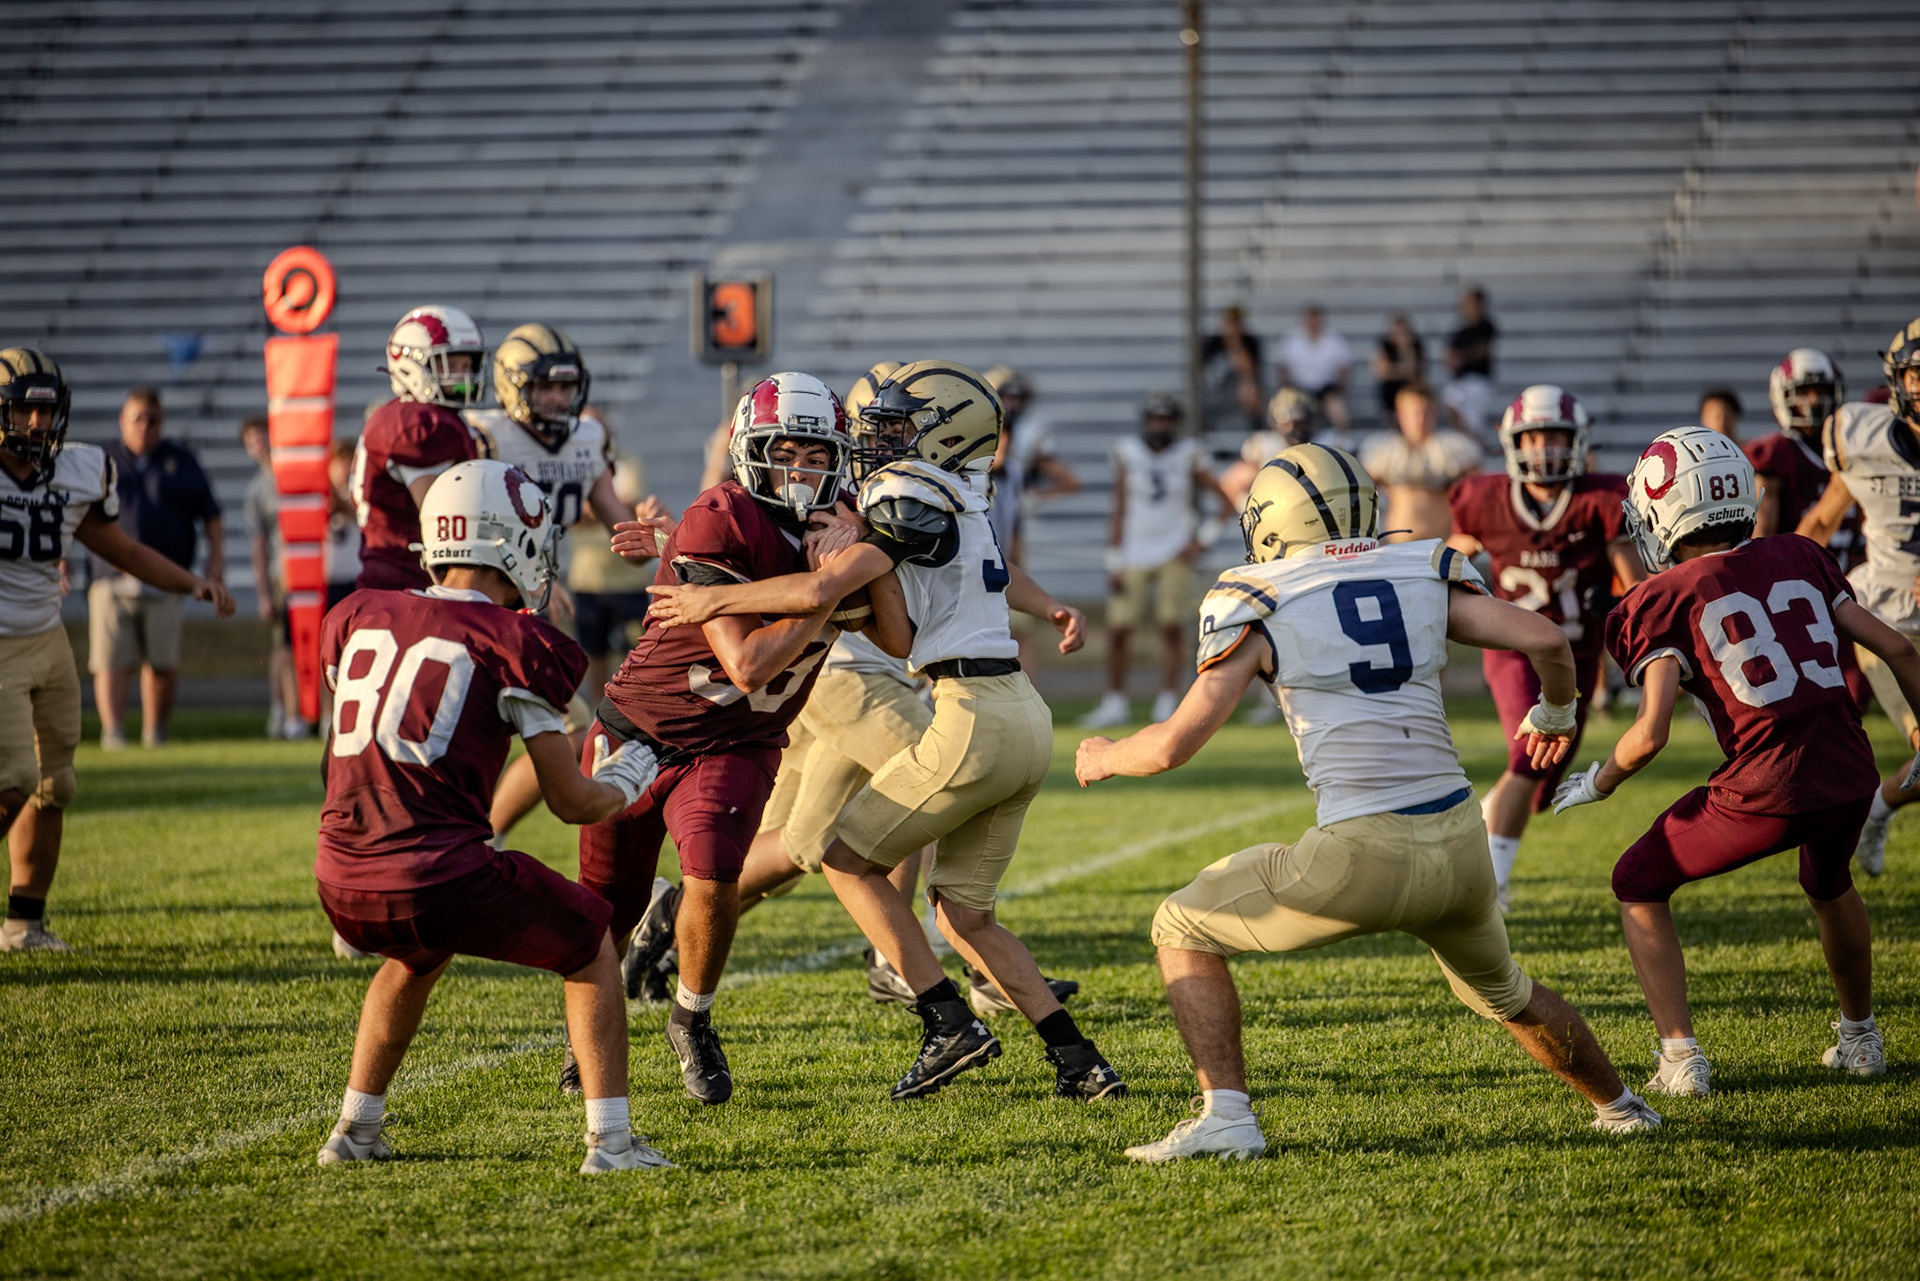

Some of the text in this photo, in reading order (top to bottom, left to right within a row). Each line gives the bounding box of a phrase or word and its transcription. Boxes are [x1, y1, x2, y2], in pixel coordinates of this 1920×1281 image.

[712, 283, 755, 347] 3
[1709, 473, 1739, 501] 83
[437, 515, 466, 541] 80
[1708, 507, 1745, 522] schutt
[432, 547, 472, 558] schutt
[1324, 541, 1376, 557] Riddell
[1332, 579, 1414, 694] 9
[1699, 579, 1846, 708] 83
[332, 628, 476, 767] 80
